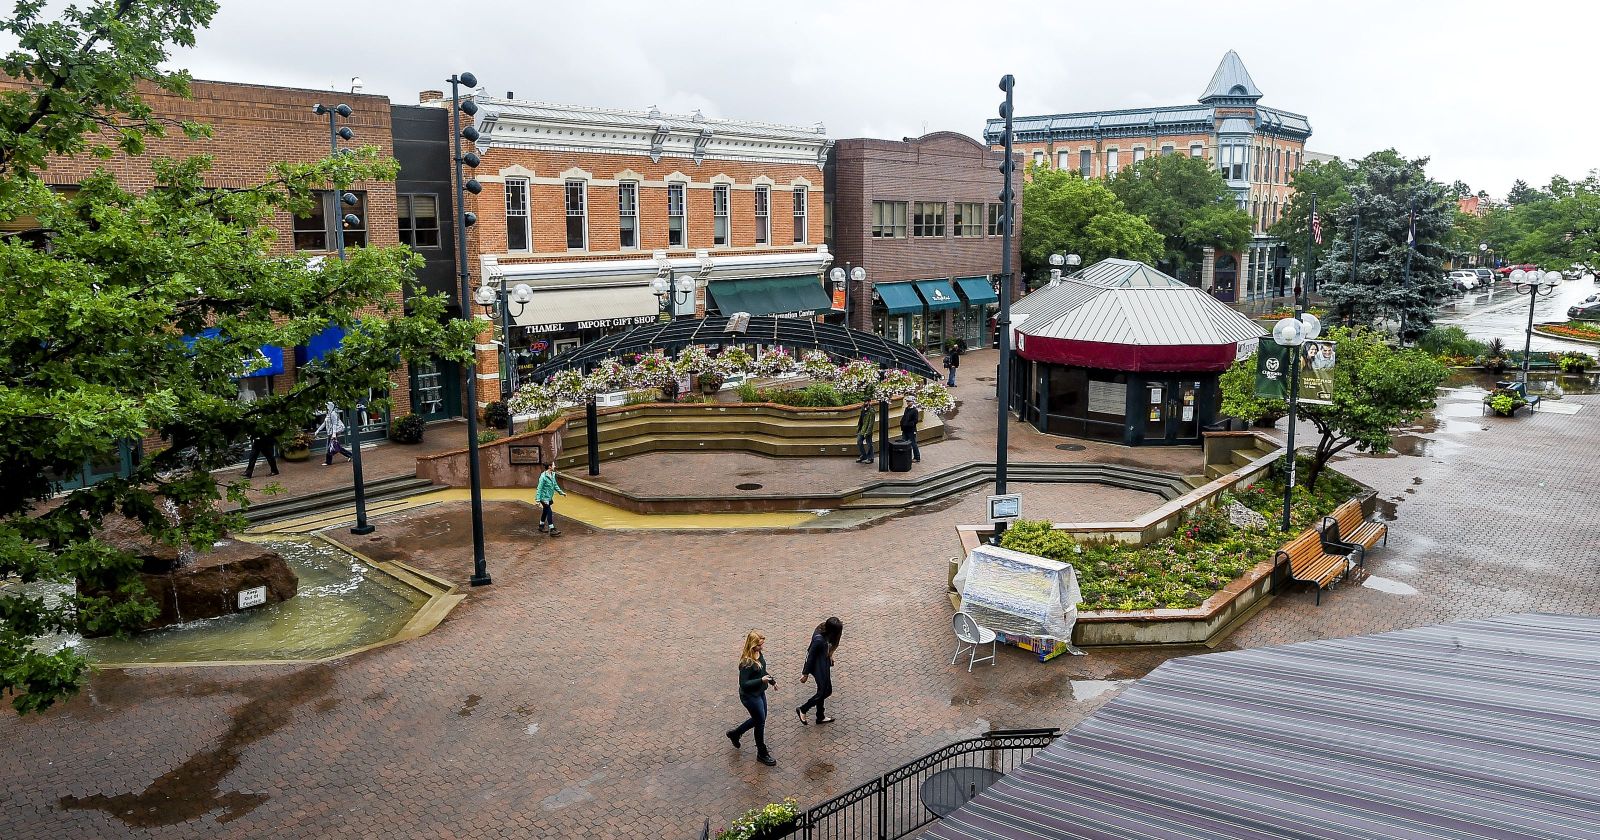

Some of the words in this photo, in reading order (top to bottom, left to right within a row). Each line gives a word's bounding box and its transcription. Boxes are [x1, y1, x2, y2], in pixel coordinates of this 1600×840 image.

[525, 323, 564, 333] THAMEL
[577, 319, 611, 329] IMPORT
[612, 317, 633, 326] GIFT
[634, 316, 655, 324] SHOP
